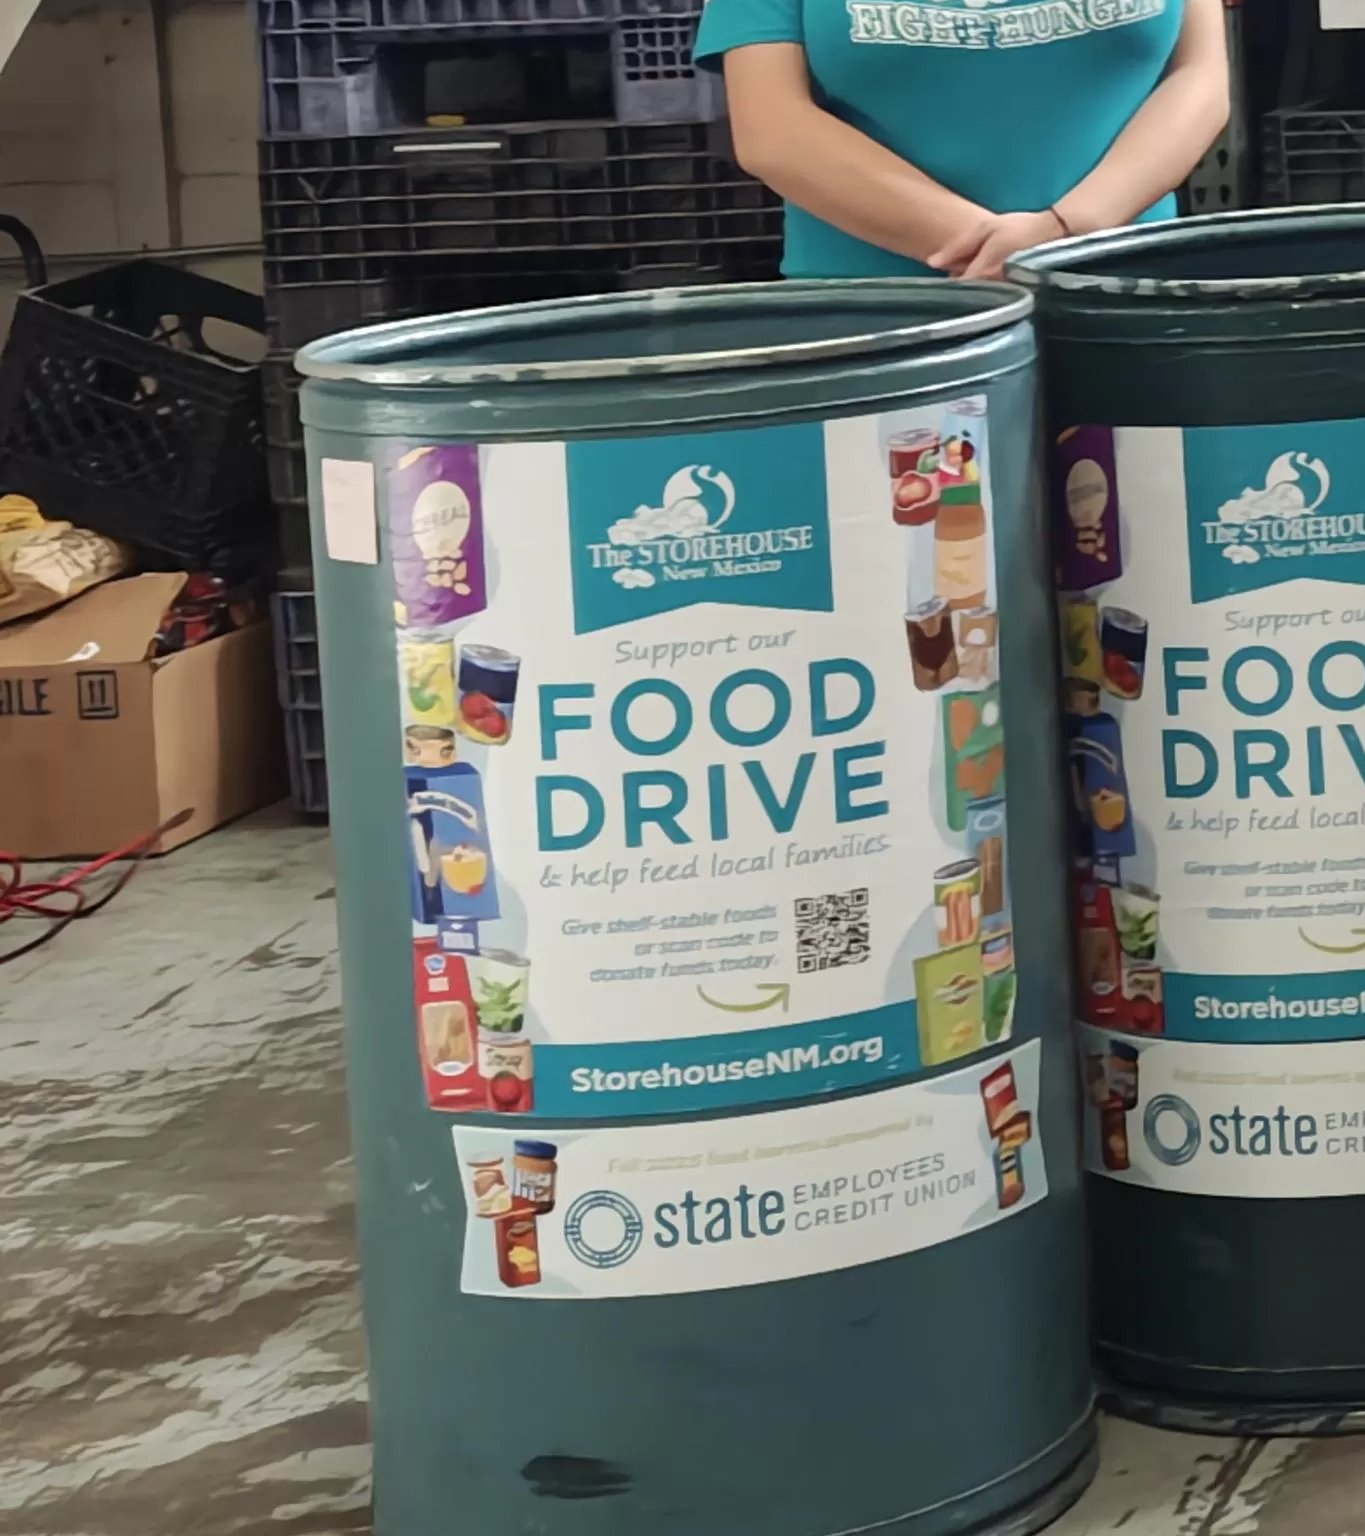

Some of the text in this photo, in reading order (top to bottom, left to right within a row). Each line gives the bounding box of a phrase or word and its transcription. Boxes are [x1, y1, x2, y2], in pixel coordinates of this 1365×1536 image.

[586, 525, 814, 568] The STOREHOUSE
[1200, 521, 1239, 544] The
[615, 629, 796, 668] Support our
[1225, 609, 1336, 636] Support
[538, 657, 876, 761] FOOD
[536, 740, 889, 852] DRIVE
[1190, 809, 1240, 839] help
[1249, 808, 1300, 832] feed
[1310, 802, 1365, 828] local
[570, 861, 628, 893] help
[639, 854, 700, 884] feed
[711, 847, 775, 876] local
[785, 833, 893, 869] families
[571, 1035, 884, 1093] StorehouseNM.org
[1209, 1105, 1318, 1157] state
[653, 1153, 946, 1248] state EMPLOYEES
[794, 1170, 977, 1232] CREDIT UNION
